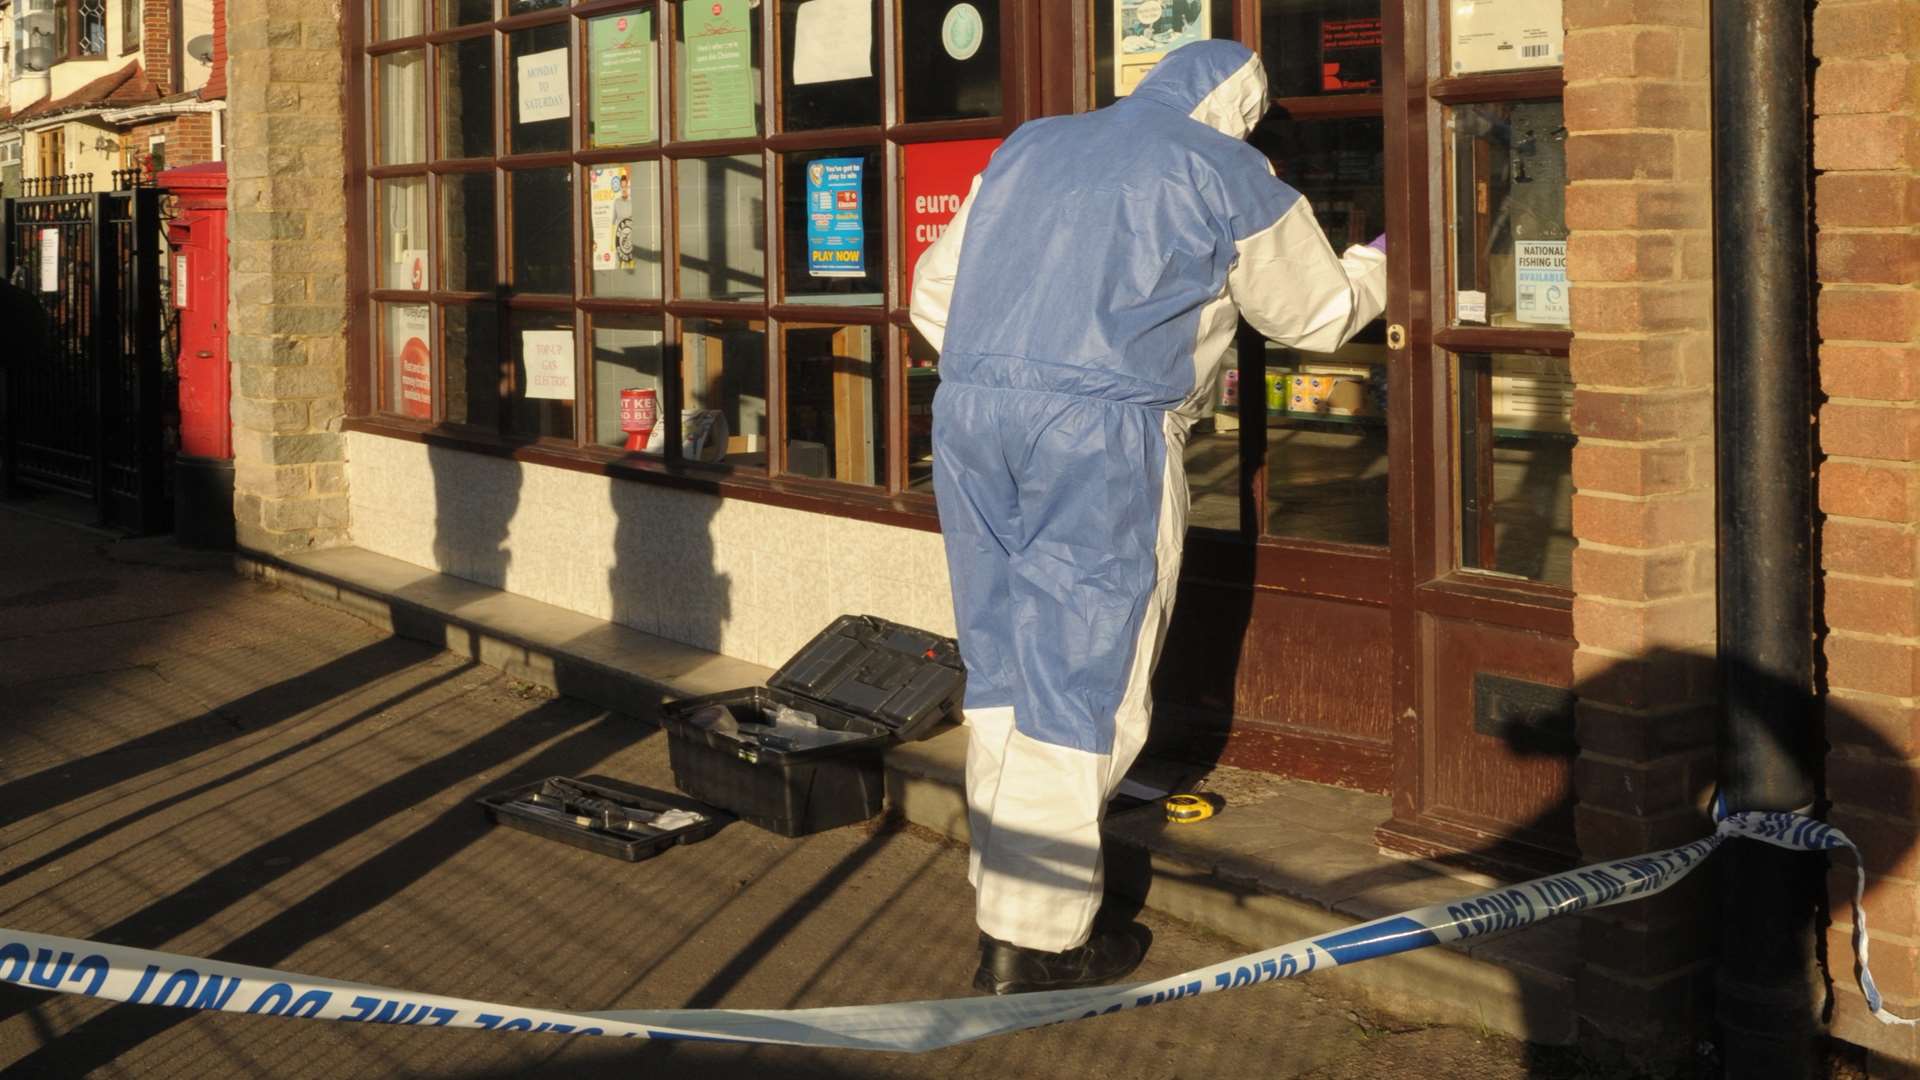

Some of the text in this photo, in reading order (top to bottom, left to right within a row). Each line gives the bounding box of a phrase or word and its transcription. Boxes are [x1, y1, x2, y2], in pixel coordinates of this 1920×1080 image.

[527, 64, 559, 78] MONDAY
[524, 95, 564, 111] SATURDAY
[915, 193, 960, 213] euro
[812, 250, 859, 262] PLAY NOW
[1523, 246, 1565, 256] NATIONAL
[1519, 257, 1551, 268] FISHING
[1545, 304, 1564, 313] NRA
[1447, 889, 1536, 939] CROSS
